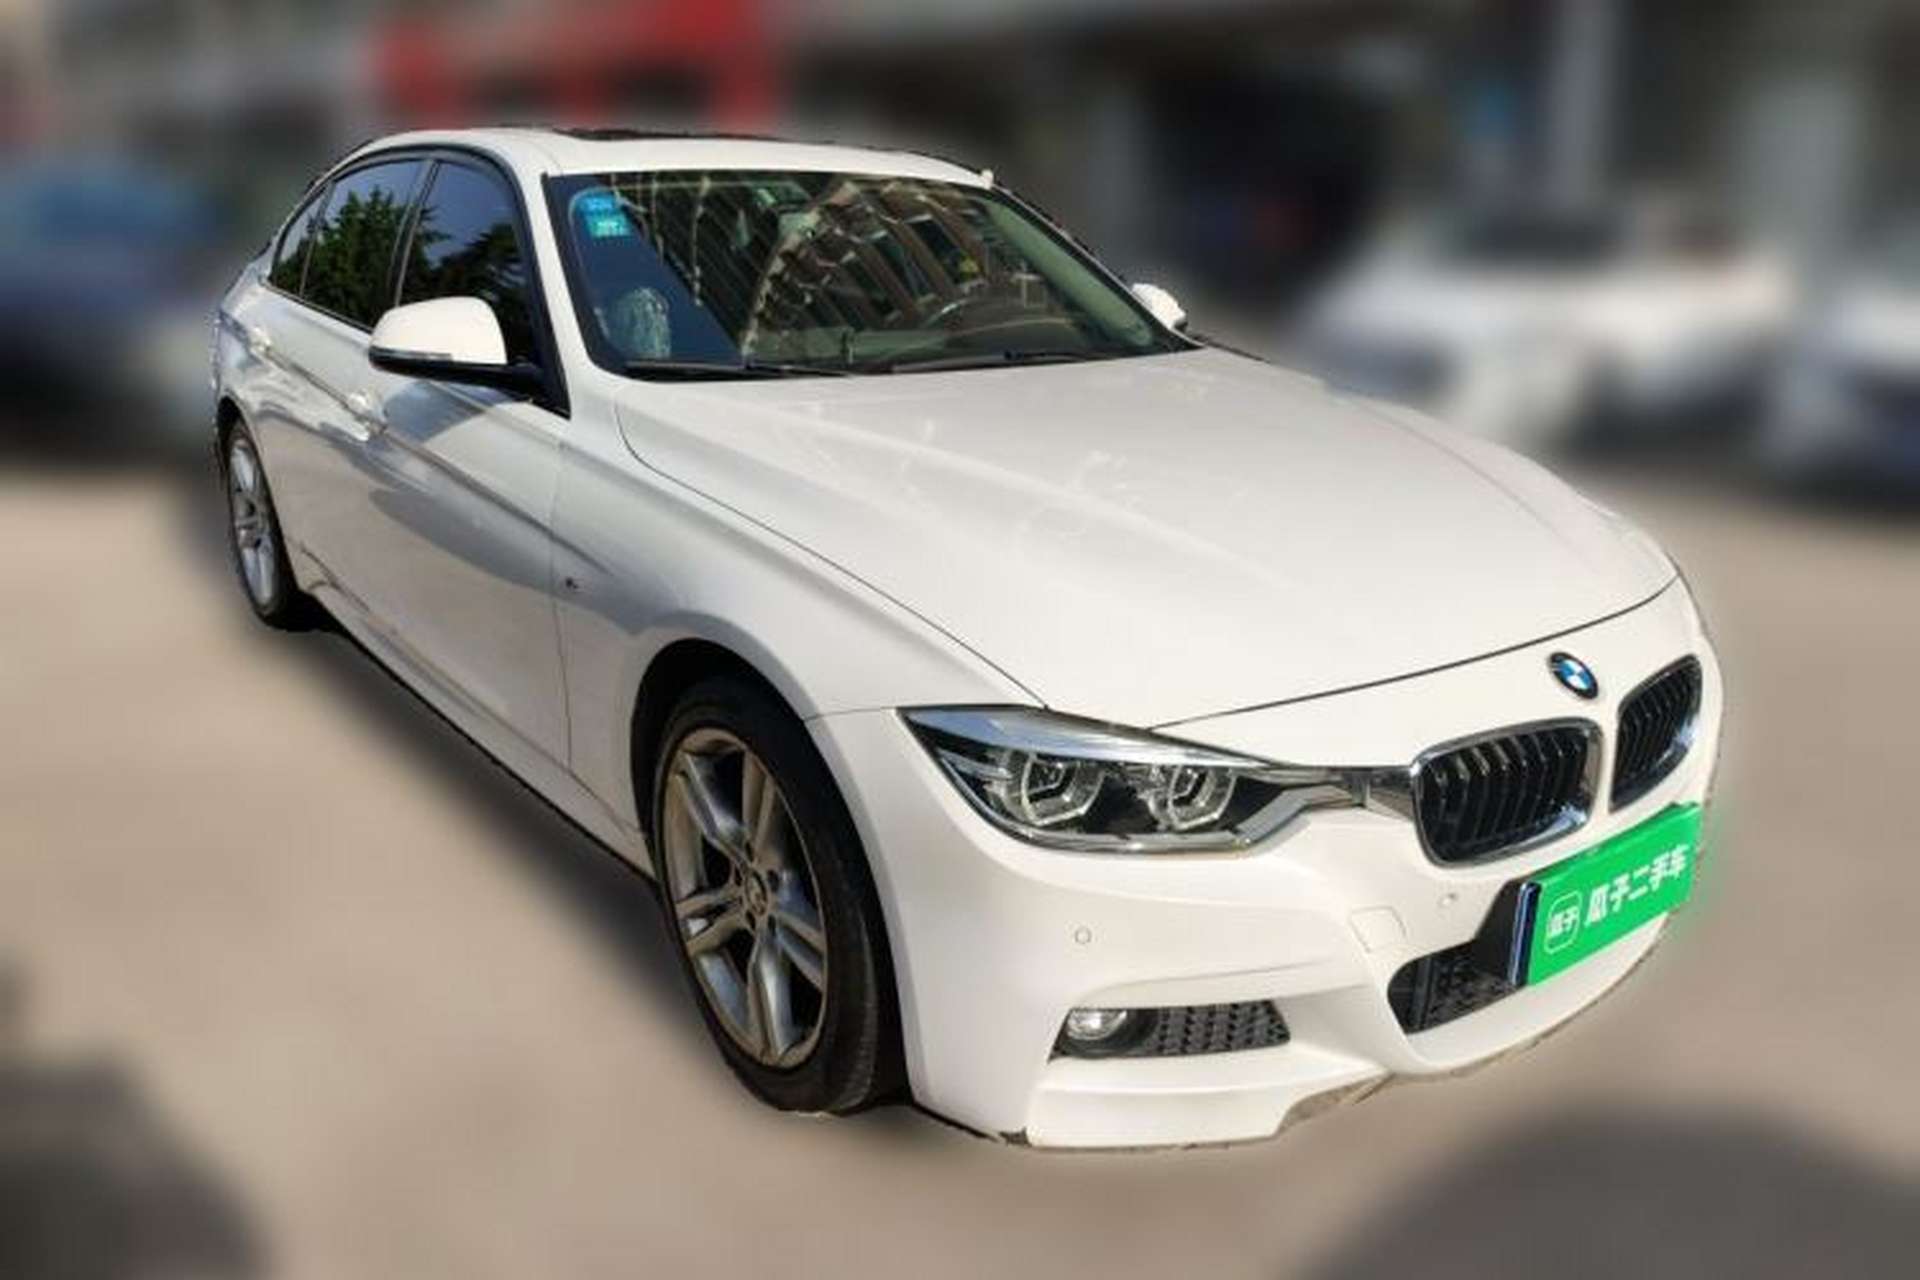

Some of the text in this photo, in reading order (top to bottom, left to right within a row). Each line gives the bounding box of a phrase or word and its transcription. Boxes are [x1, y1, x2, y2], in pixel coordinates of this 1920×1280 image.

[1586, 844, 1690, 925] 瓜子二手车
